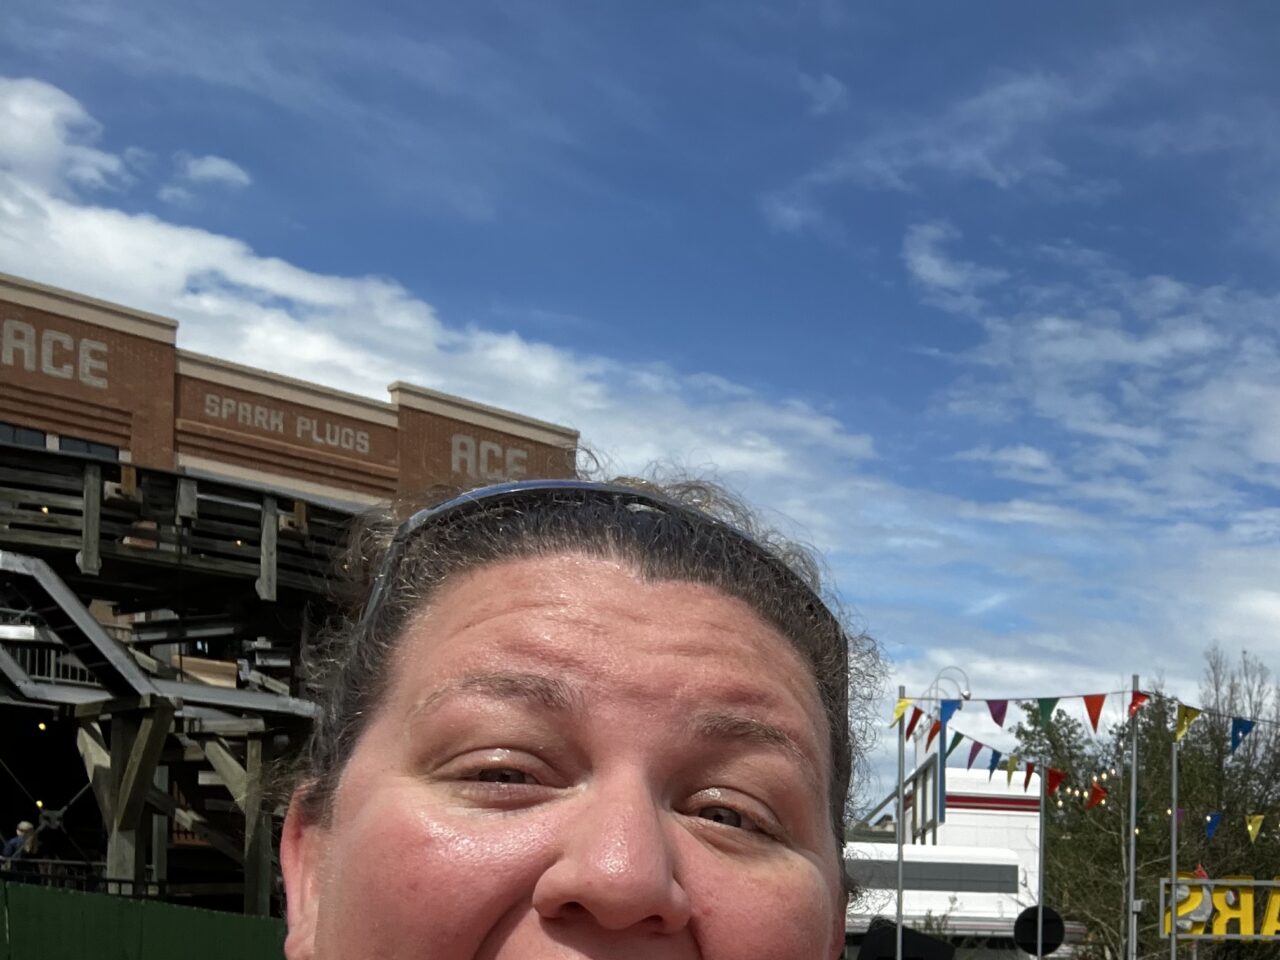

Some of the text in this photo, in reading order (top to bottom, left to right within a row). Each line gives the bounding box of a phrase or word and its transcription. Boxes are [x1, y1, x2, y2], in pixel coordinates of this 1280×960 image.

[2, 318, 108, 390] ACE
[205, 393, 369, 454] SPARK PLUGS
